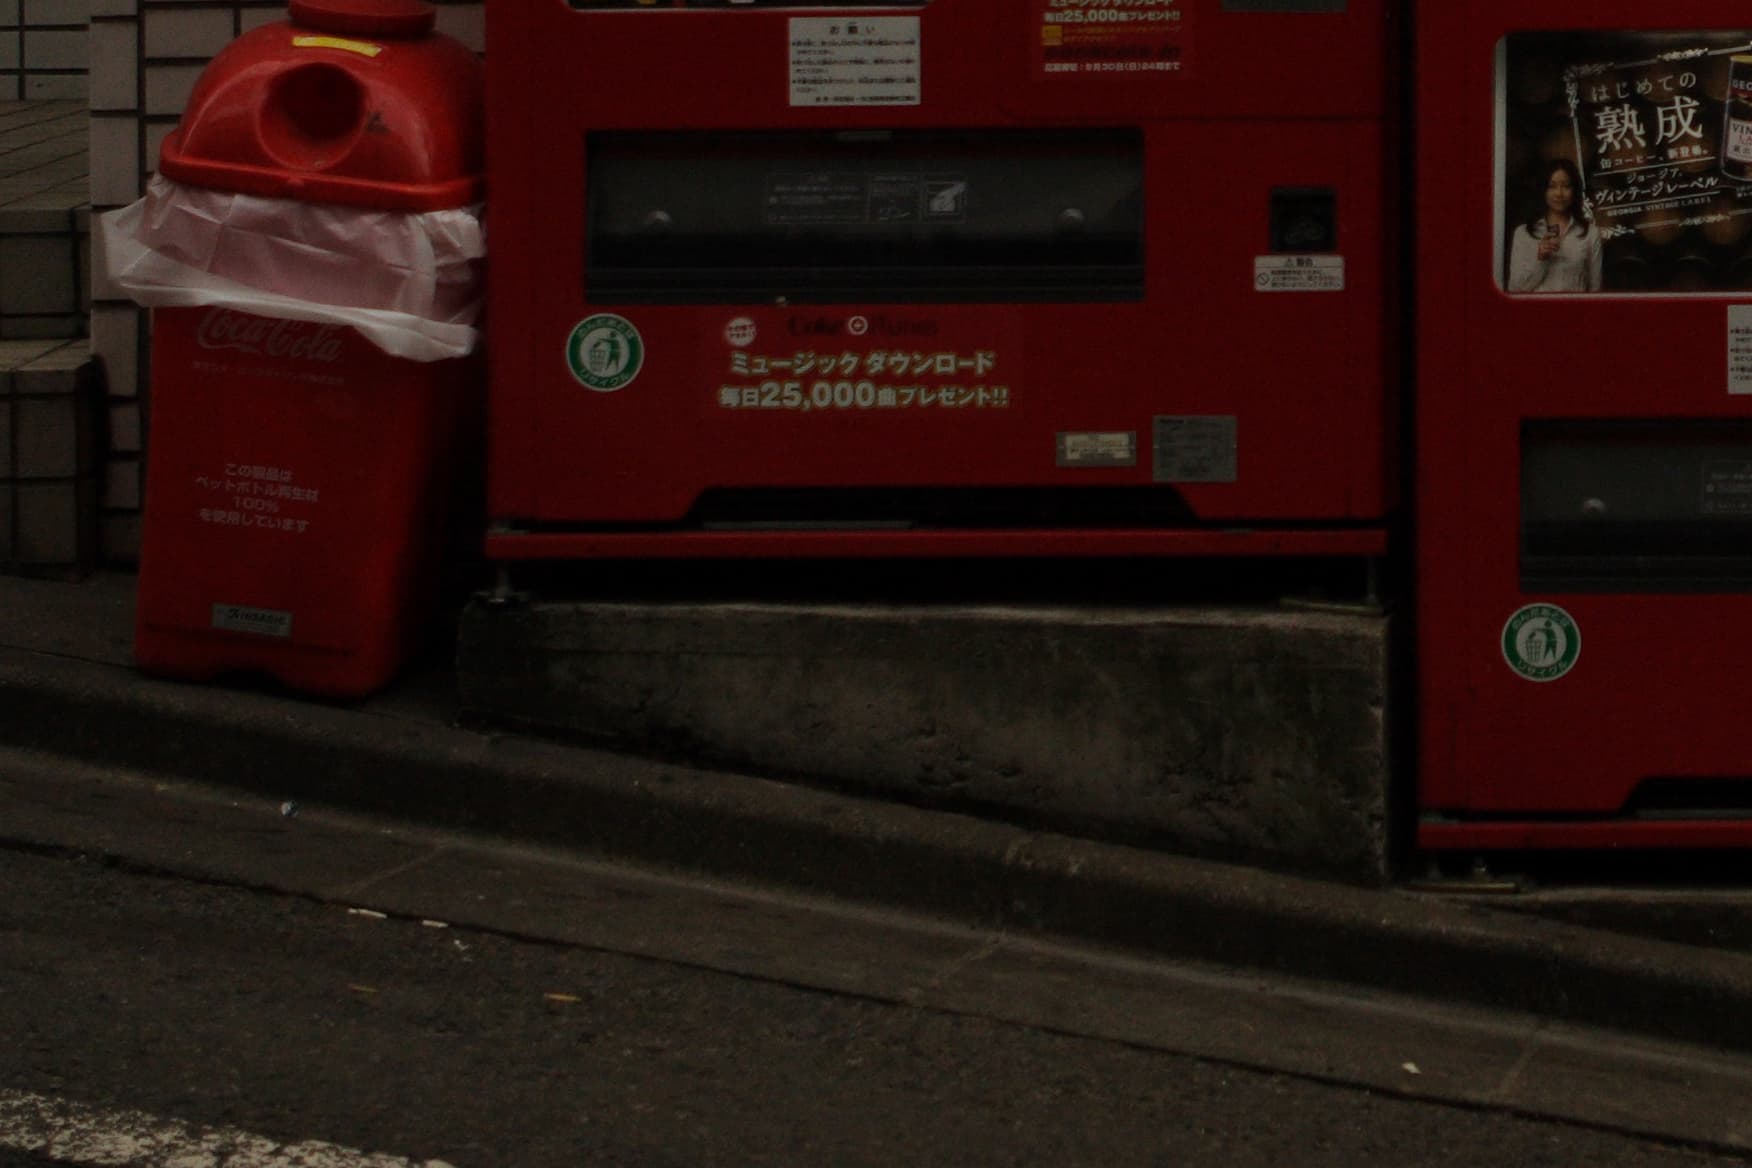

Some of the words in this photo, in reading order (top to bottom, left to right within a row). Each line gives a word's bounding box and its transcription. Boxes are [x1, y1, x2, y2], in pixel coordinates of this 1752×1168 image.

[1592, 71, 1696, 102] はじめての
[1595, 95, 1704, 154] 熟成
[728, 351, 862, 376] ミュージック
[866, 351, 996, 376] ダウンロード
